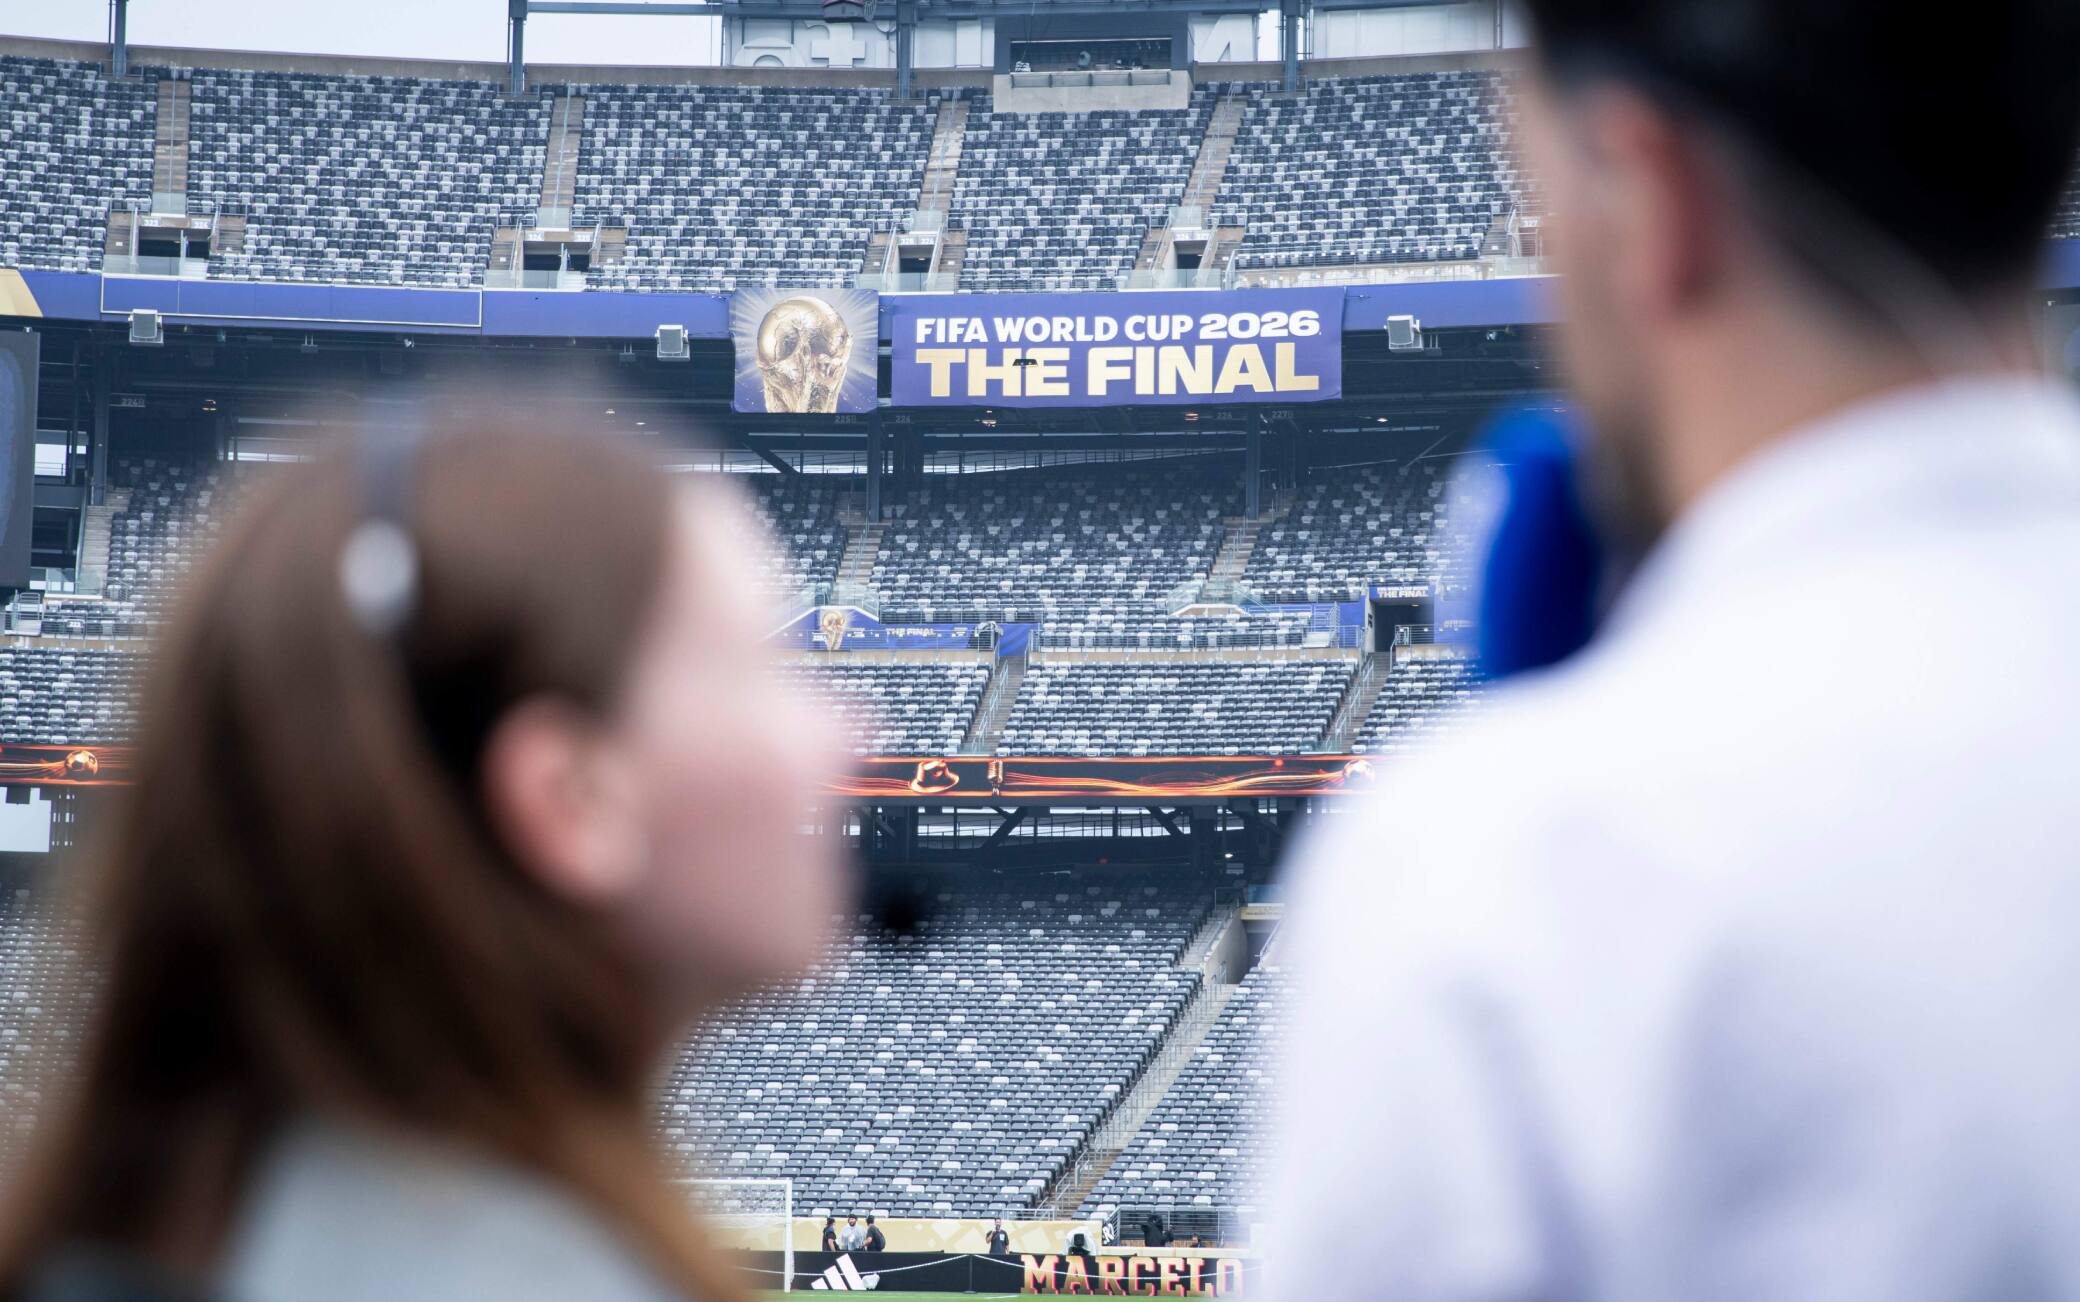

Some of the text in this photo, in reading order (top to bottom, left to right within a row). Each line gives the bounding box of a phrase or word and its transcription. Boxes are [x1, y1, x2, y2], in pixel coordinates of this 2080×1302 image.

[916, 310, 1320, 343] FIFA WORLD CUP 2026
[916, 342, 1320, 397] THE FINAL
[1378, 589, 1429, 598] THE FINAL
[884, 627, 937, 637] THE FINAL
[1020, 1254, 1245, 1298] MARCELO
